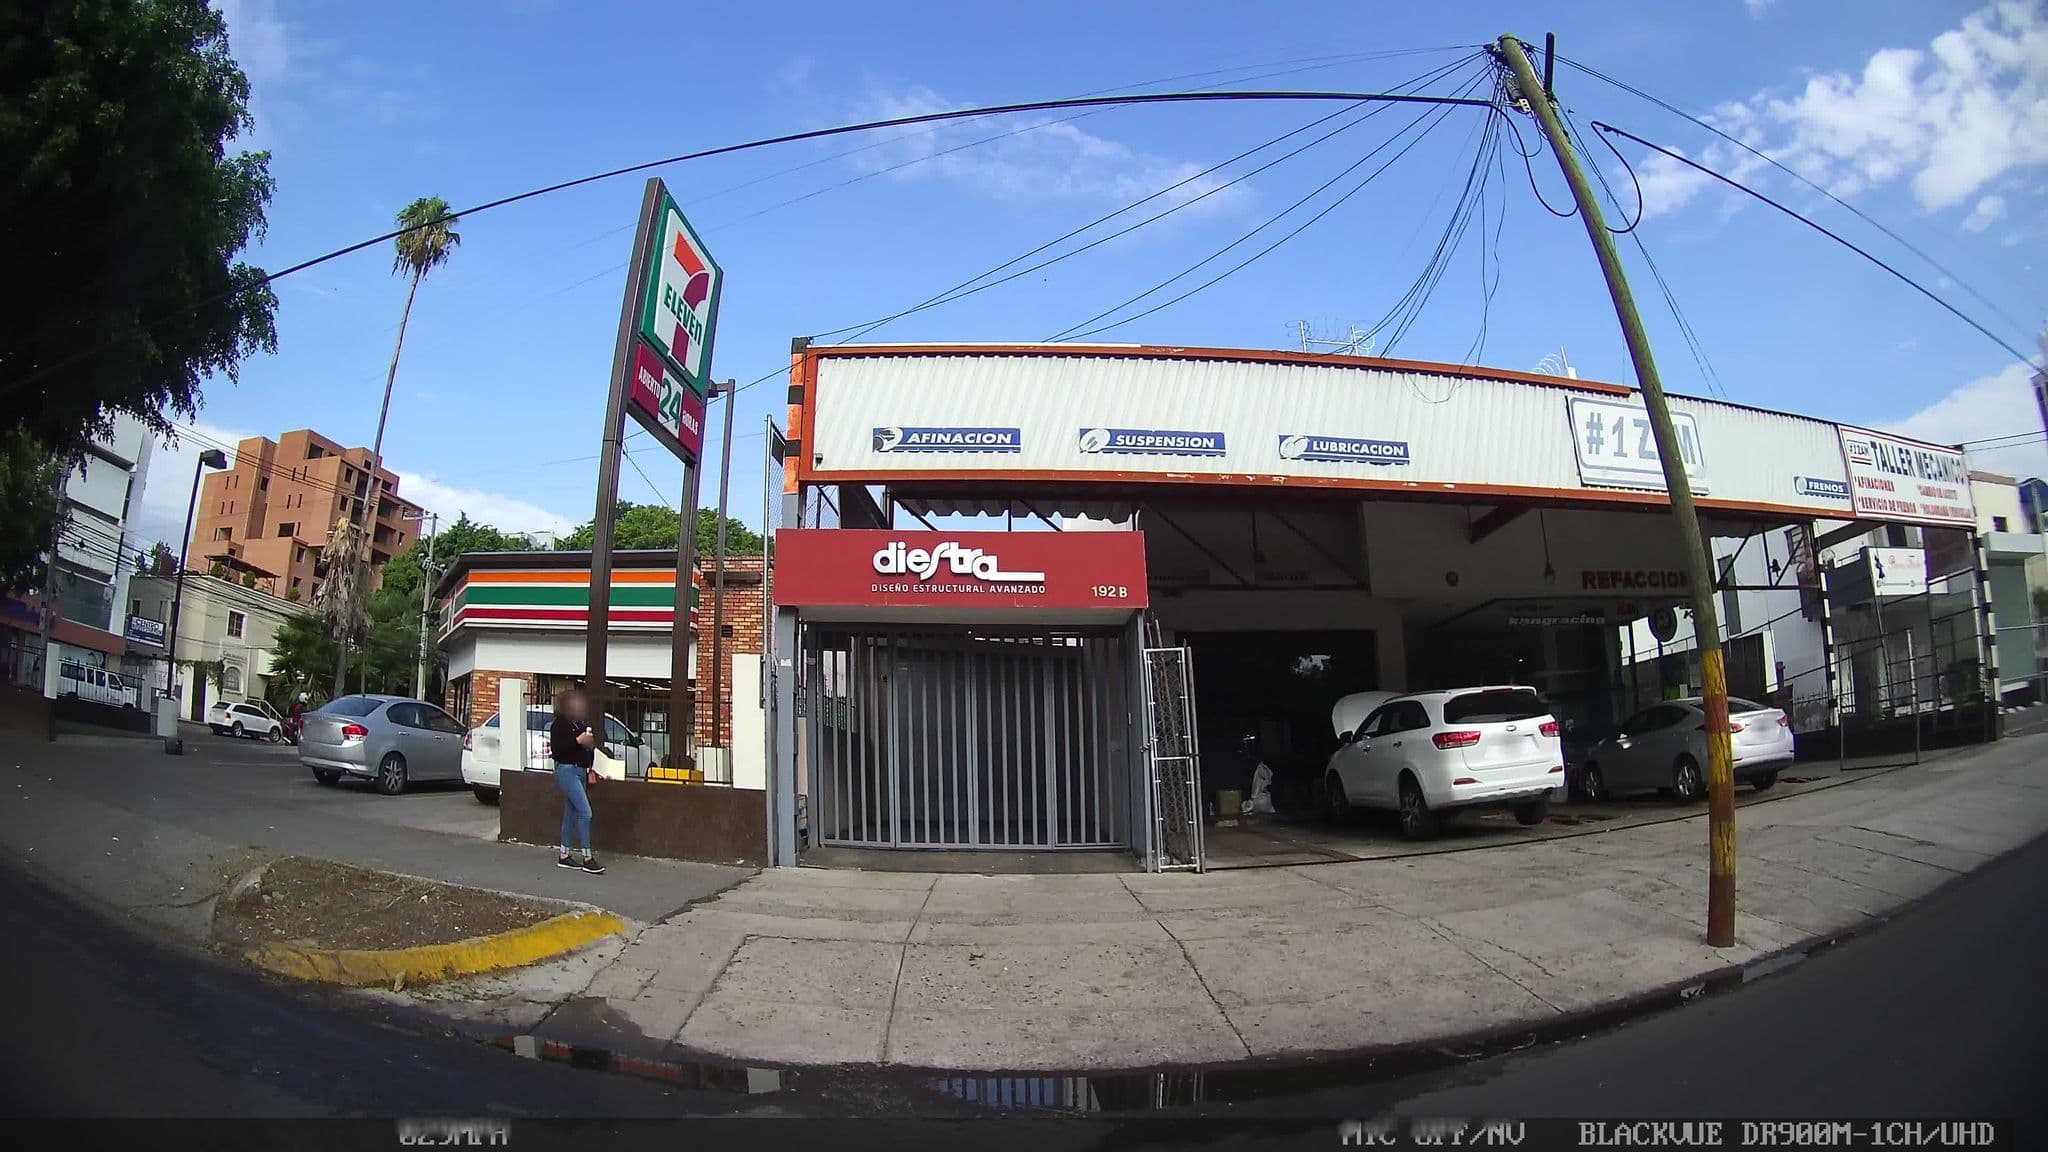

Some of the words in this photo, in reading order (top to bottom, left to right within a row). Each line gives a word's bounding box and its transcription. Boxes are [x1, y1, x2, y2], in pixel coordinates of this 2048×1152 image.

[670, 230, 710, 369] 7
[638, 366, 661, 399] ABIERTO
[660, 378, 681, 429] 24
[907, 432, 1012, 444] AFINACION
[1115, 434, 1215, 449] SUSPENSION
[1312, 439, 1404, 456] LUBRICACION
[1870, 440, 1916, 477] TALLER
[1808, 481, 1844, 492] FRENOS
[873, 541, 1045, 581] diestra
[871, 583, 909, 592] DISEÑO
[912, 584, 985, 593] ESTRUCTURAL
[989, 585, 1046, 594] AVANZADO
[1091, 585, 1117, 598] 192
[1119, 588, 1128, 598] B
